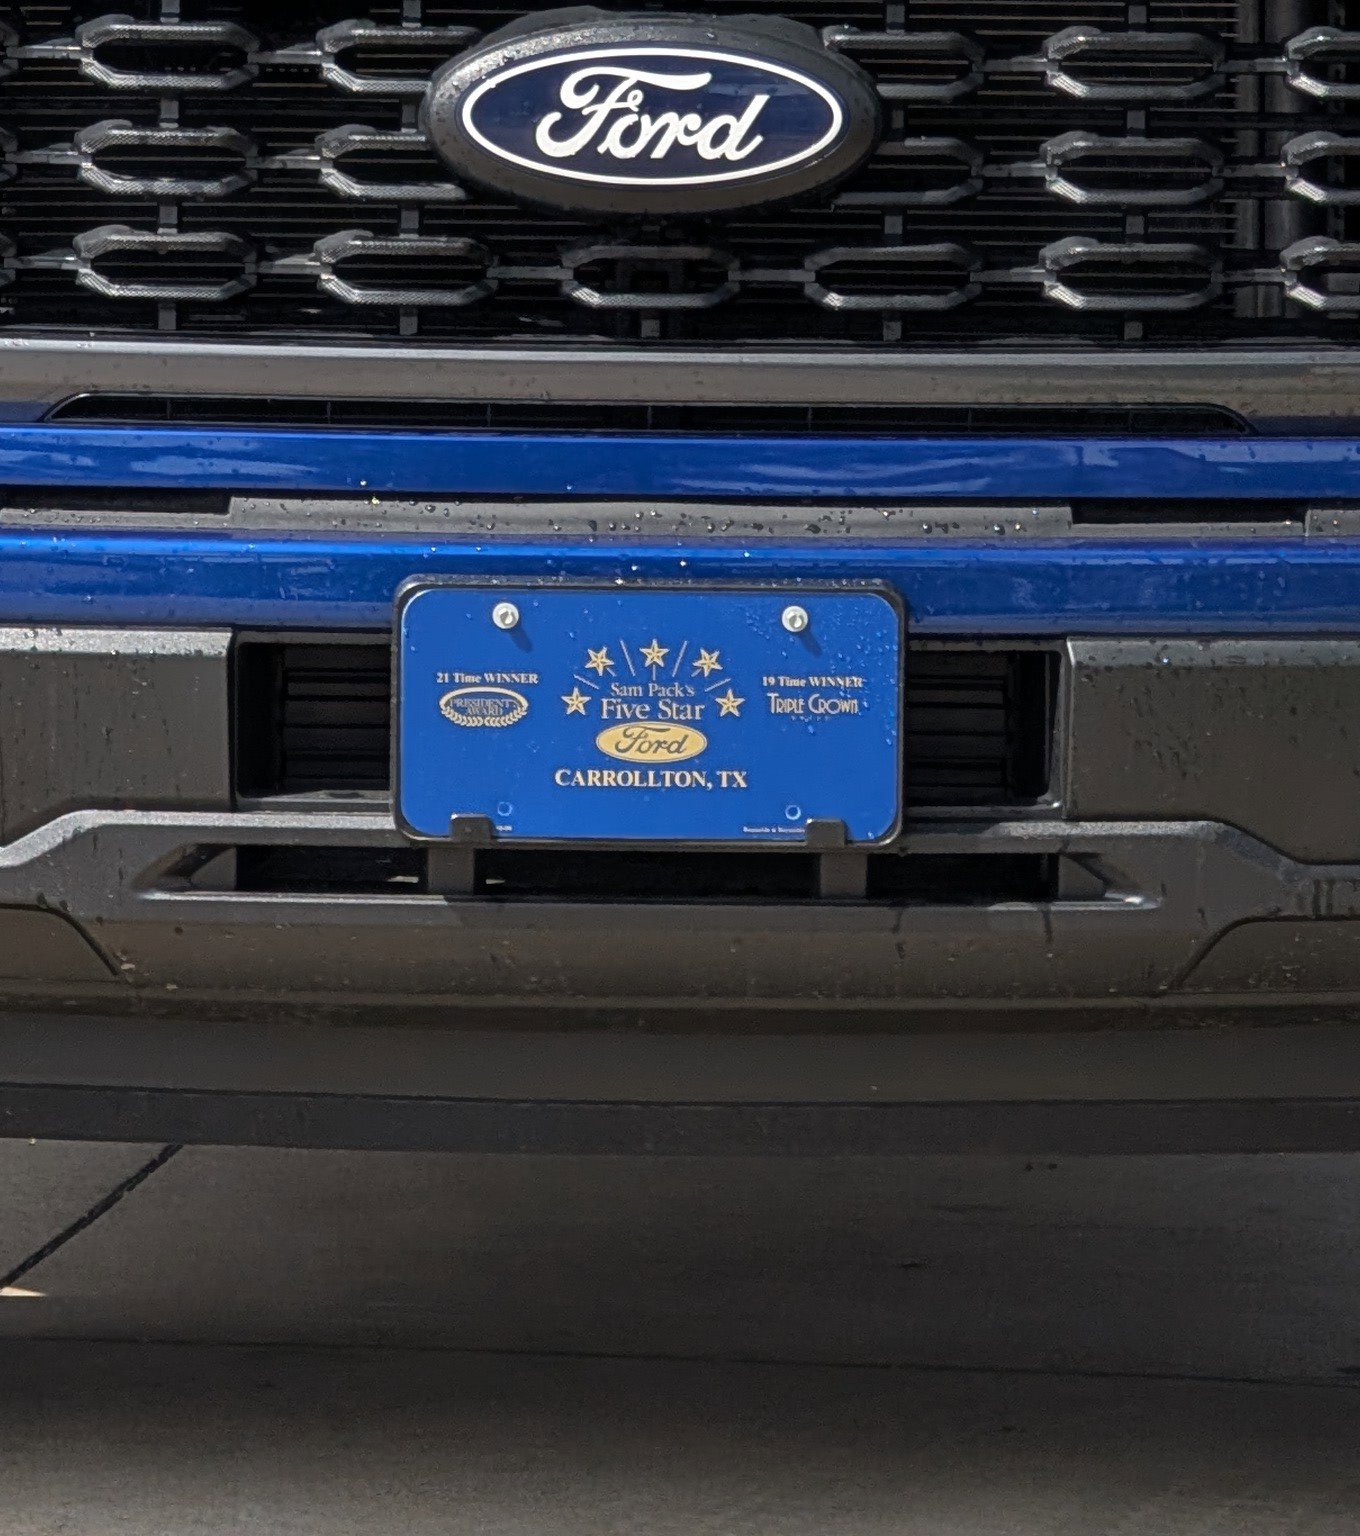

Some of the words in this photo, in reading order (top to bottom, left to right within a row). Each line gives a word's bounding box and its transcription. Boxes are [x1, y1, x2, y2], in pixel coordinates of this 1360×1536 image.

[535, 67, 770, 160] Ford
[436, 672, 449, 683] 21
[453, 672, 481, 683] Time
[484, 672, 539, 684] WINNER
[762, 676, 775, 687] 19
[778, 676, 806, 687] Time
[808, 676, 863, 688] WINNER
[611, 682, 643, 697] Sam
[648, 682, 696, 697] Pack's
[601, 698, 650, 720] Five
[658, 698, 706, 720] Star
[615, 725, 689, 754] Ford
[554, 769, 713, 790] CARROLLTON,
[717, 770, 748, 788] TX
